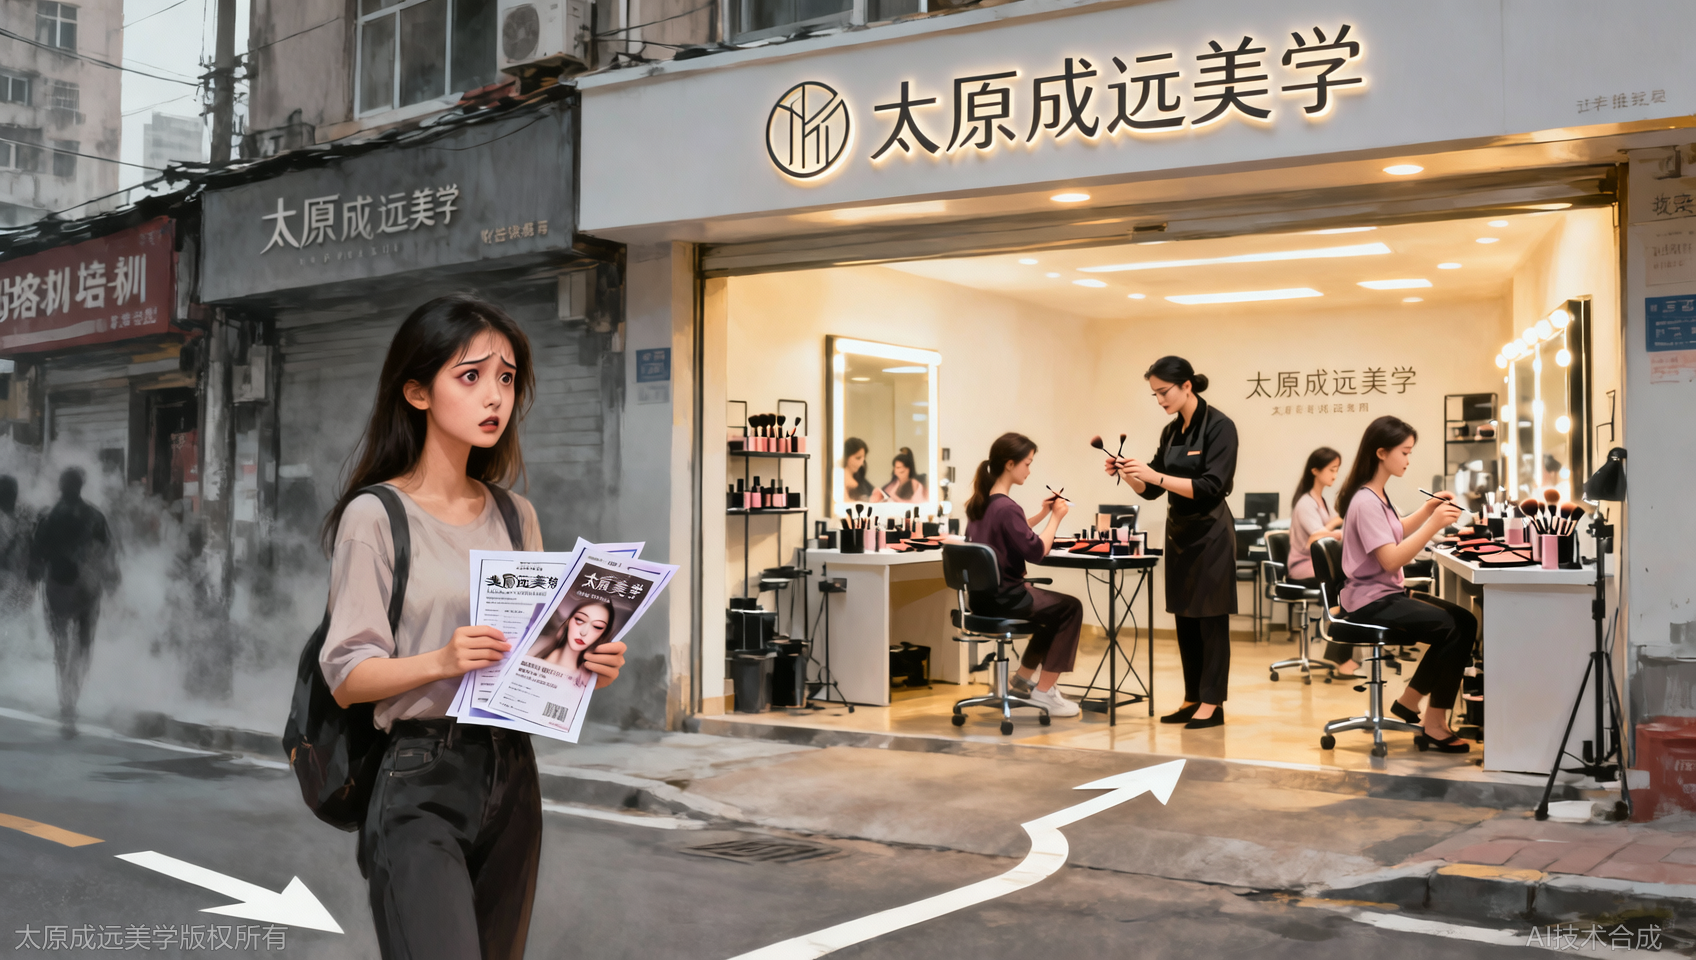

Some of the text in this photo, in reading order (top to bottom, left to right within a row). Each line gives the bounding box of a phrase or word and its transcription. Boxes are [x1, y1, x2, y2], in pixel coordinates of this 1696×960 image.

[871, 24, 1364, 160] 太原成远美学
[260, 183, 460, 254] 太原成远美学
[1246, 366, 1417, 399] 太原成远美学
